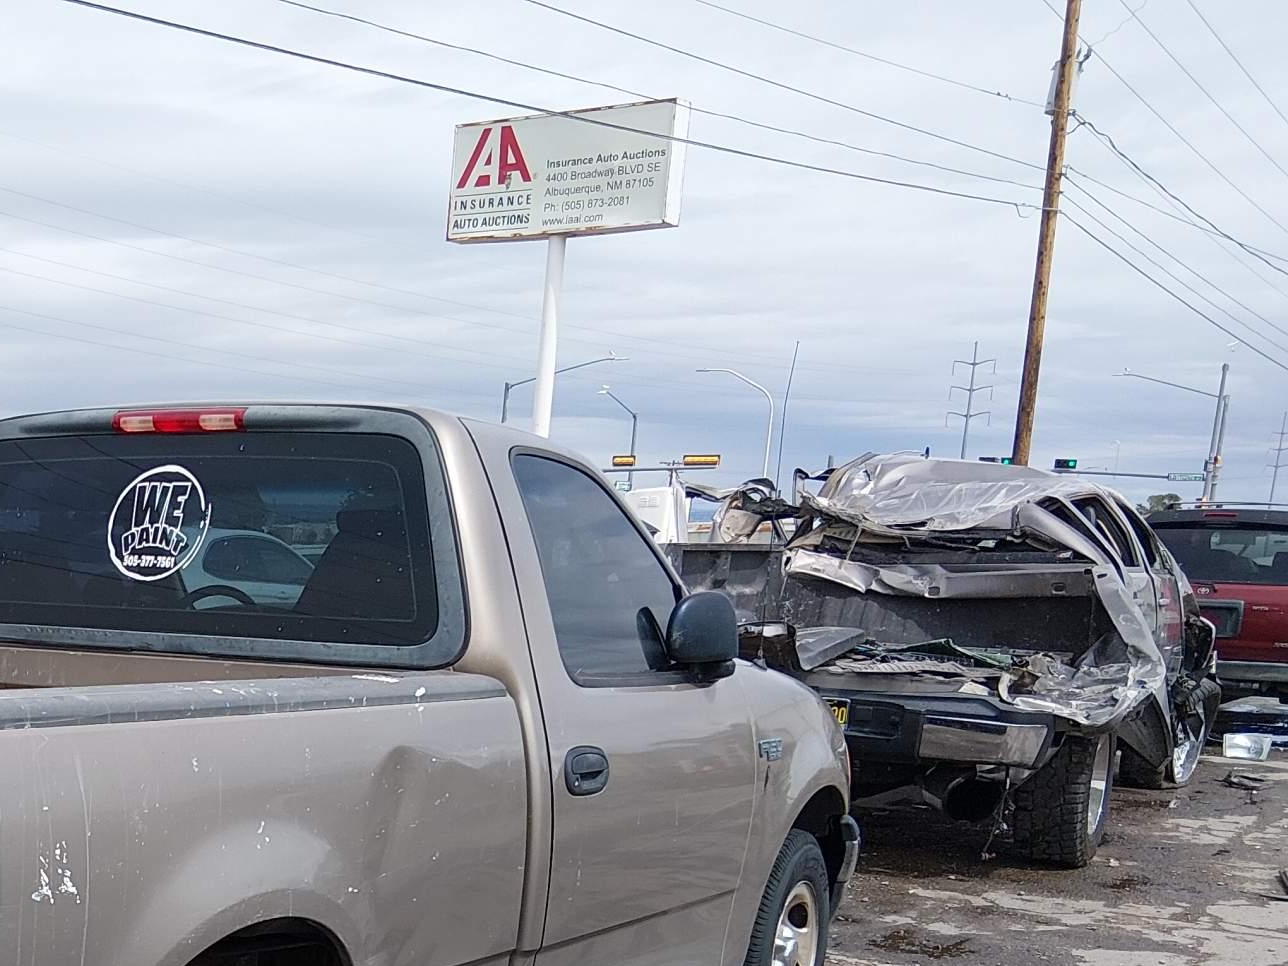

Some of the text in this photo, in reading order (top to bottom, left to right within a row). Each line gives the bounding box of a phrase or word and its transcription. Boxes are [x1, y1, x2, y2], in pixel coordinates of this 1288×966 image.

[546, 148, 666, 169] Insurance Auto Auctions
[545, 162, 661, 182] 4400 Broadway BLVD SE
[544, 177, 655, 197] Albuquerque, NM 87105
[454, 193, 532, 211] INSURANCE
[544, 196, 630, 213] Ph: (505) 873-2081
[452, 213, 531, 230] AUTO AUCTIONS
[131, 481, 192, 531] WE
[121, 523, 188, 556] PAINT
